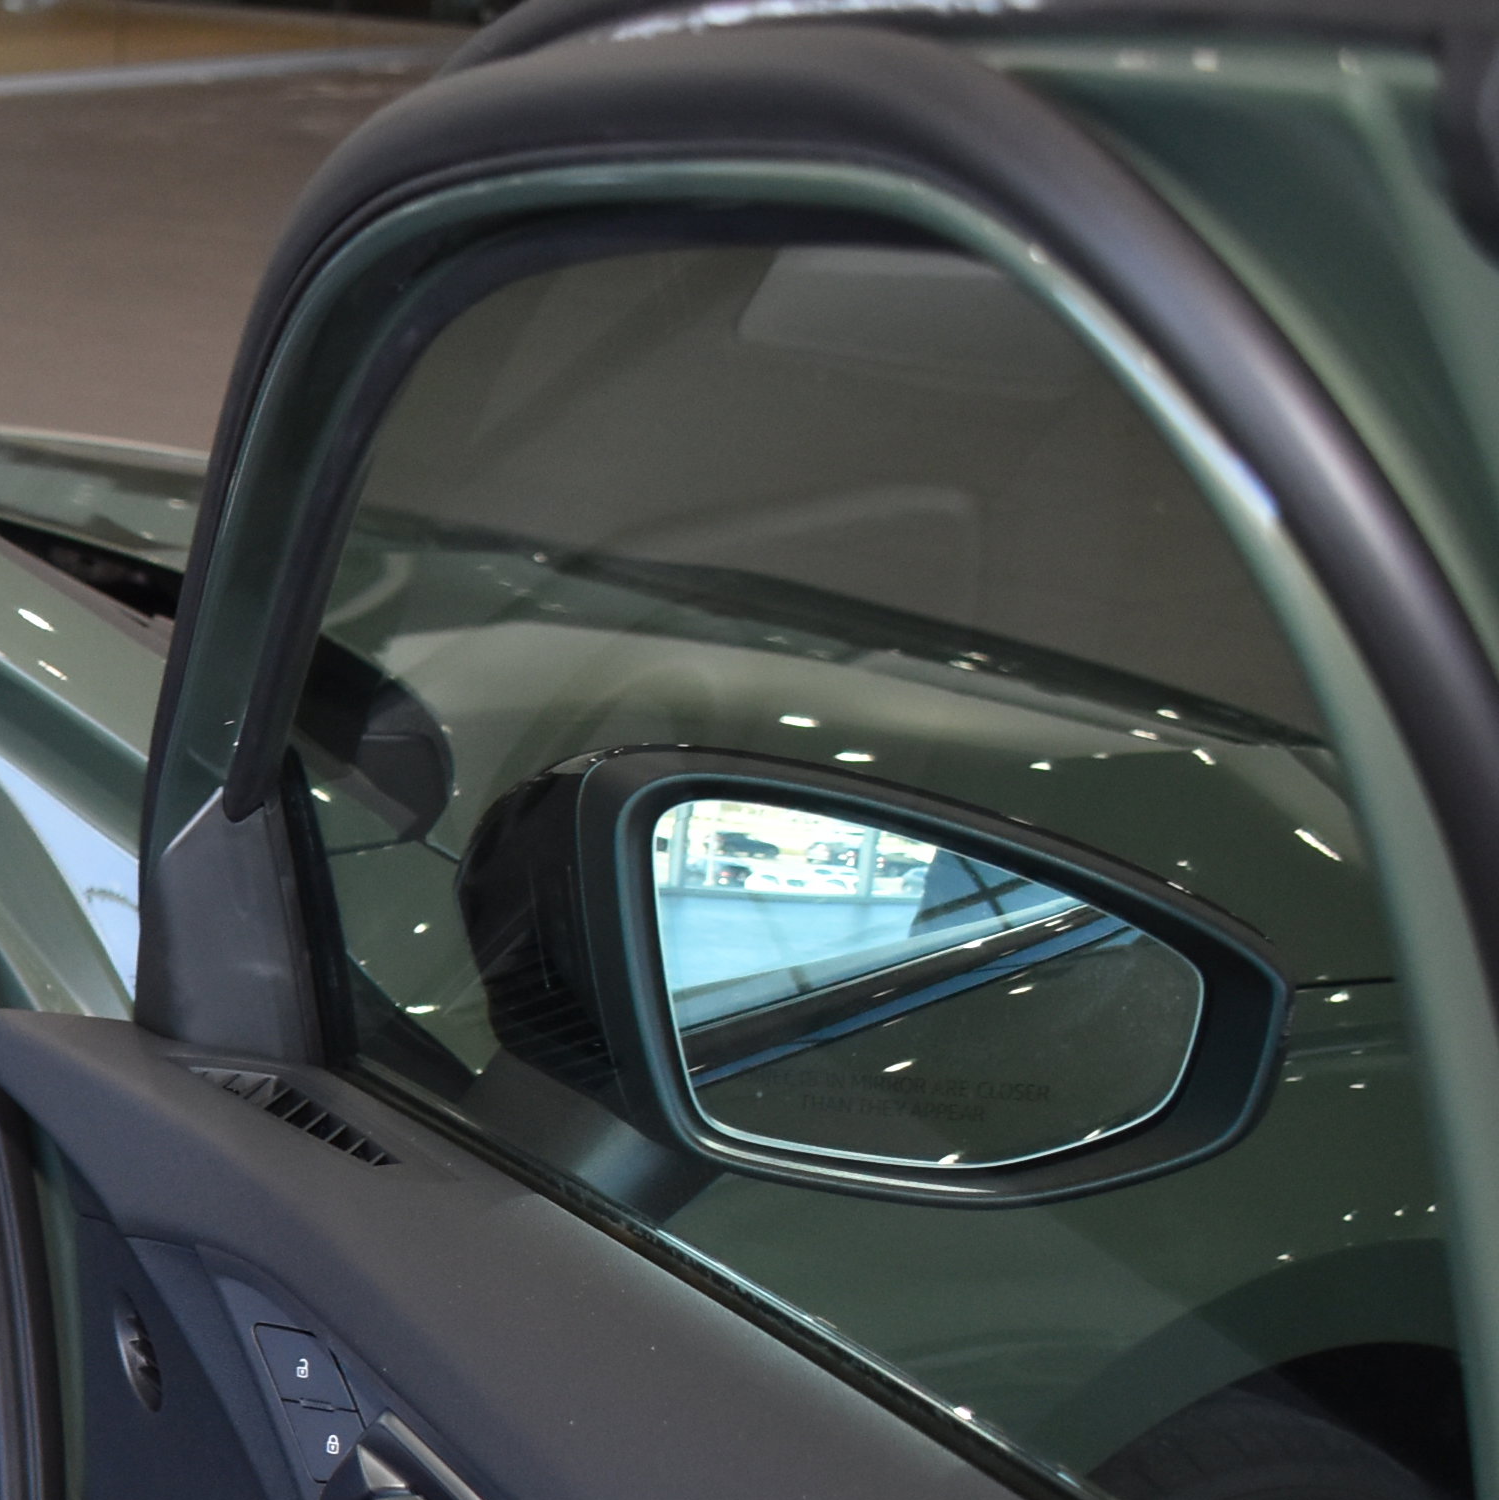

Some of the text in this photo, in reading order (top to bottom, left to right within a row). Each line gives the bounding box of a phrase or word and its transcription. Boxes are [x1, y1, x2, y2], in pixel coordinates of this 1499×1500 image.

[850, 1072, 928, 1096] MIRROR
[931, 1078, 970, 1099] ARE
[977, 1080, 1051, 1103] CLOSER
[801, 1093, 986, 1123] THAN THEY APPEAR
